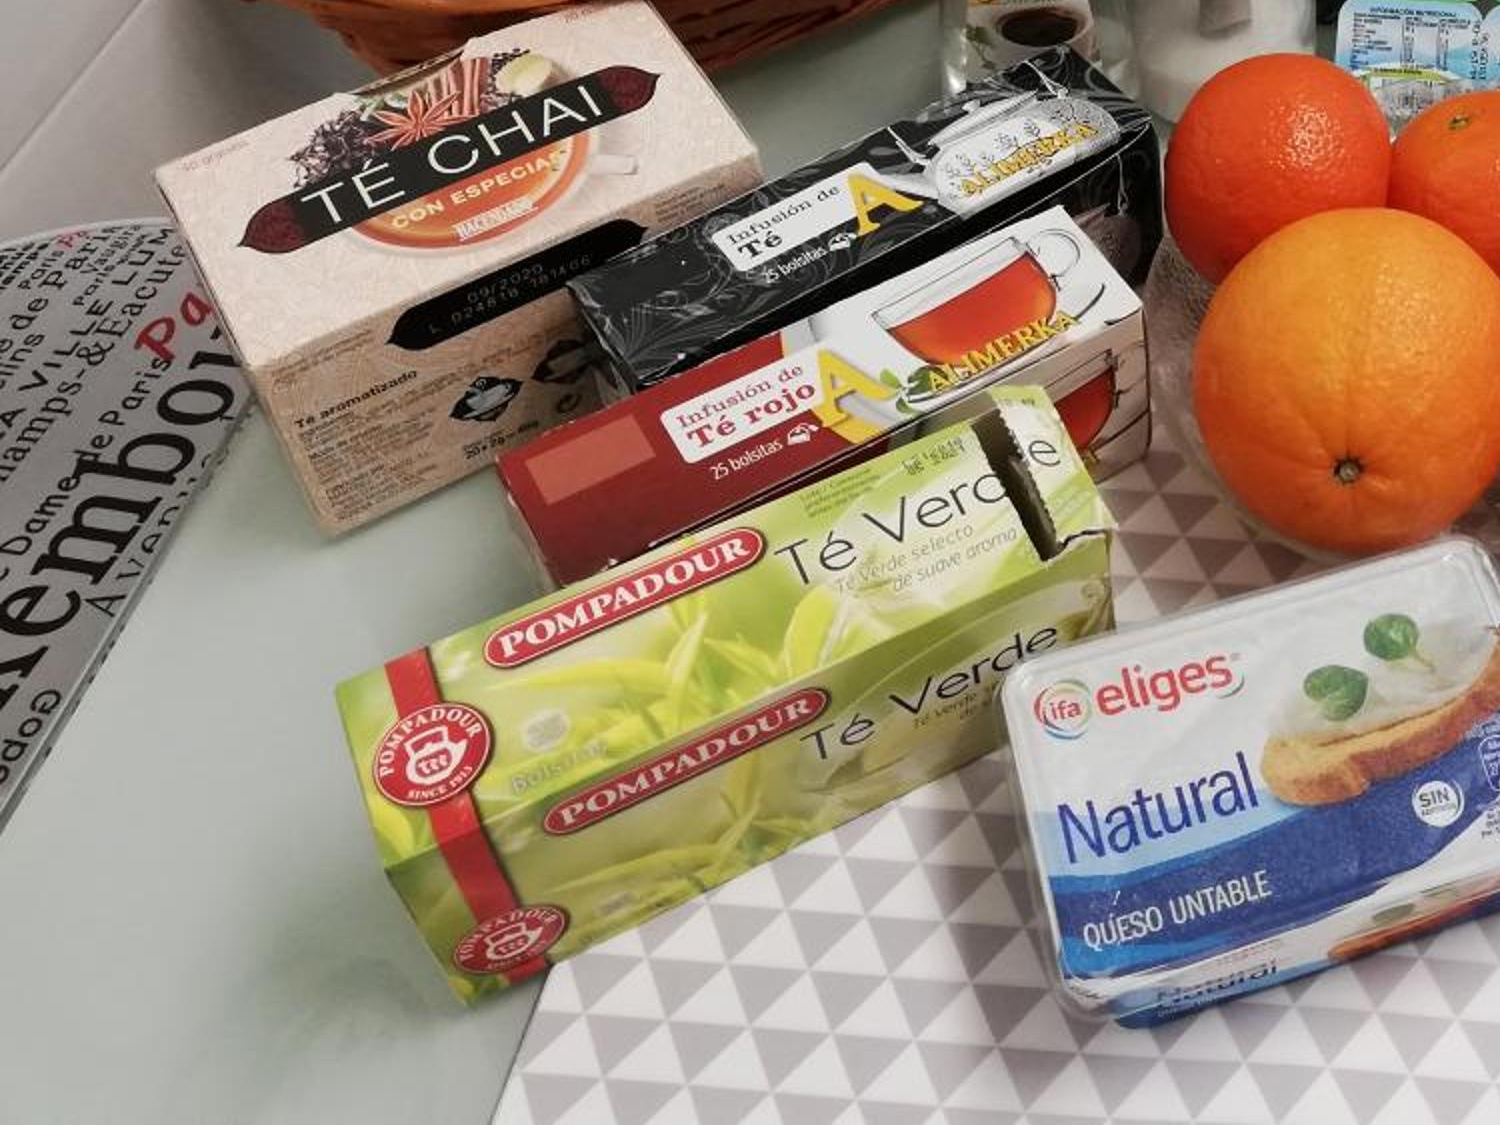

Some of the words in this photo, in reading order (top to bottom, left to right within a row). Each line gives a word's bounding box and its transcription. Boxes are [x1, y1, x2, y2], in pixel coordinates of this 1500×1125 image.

[301, 158, 405, 223] TÉ
[427, 85, 602, 174] CHAI
[961, 122, 1099, 197] ALIMERKA
[391, 199, 446, 231] CON
[726, 199, 812, 245] Infusión
[816, 184, 841, 203] de
[848, 173, 924, 237] A
[18, 250, 65, 290] Paris
[738, 231, 783, 259] Té
[780, 244, 828, 276] bolsitas
[9, 297, 49, 331] de
[17, 299, 114, 391] VILLE
[112, 228, 176, 286] LUM
[927, 309, 1079, 393] ALIMERKA
[320, 369, 419, 417] aromatizado
[675, 379, 772, 429] Infusión
[777, 364, 804, 383] de
[686, 416, 737, 448] Té
[747, 383, 816, 425] rojo
[812, 347, 898, 429] A
[0, 474, 81, 556] Dame
[99, 357, 172, 426] Paris
[710, 461, 729, 482] 25
[729, 438, 784, 471] bolsitas
[774, 531, 857, 585] Té
[860, 551, 908, 583] Verde
[911, 523, 974, 558] selecto
[893, 572, 915, 593] de
[914, 555, 962, 585] suave
[966, 527, 1019, 558] aroma
[497, 537, 753, 661] POMPADOUR
[800, 713, 874, 759] Té
[889, 628, 1057, 715] Verde
[1049, 699, 1083, 721] ifa
[1096, 653, 1233, 716] eliges
[379, 708, 483, 778] POMPADOUR
[558, 696, 812, 827] POMPADOUR
[1057, 750, 1260, 864] Natural
[1418, 787, 1451, 809] SIN
[1084, 906, 1164, 952] QUESO
[1168, 869, 1273, 925] UNTABLE
